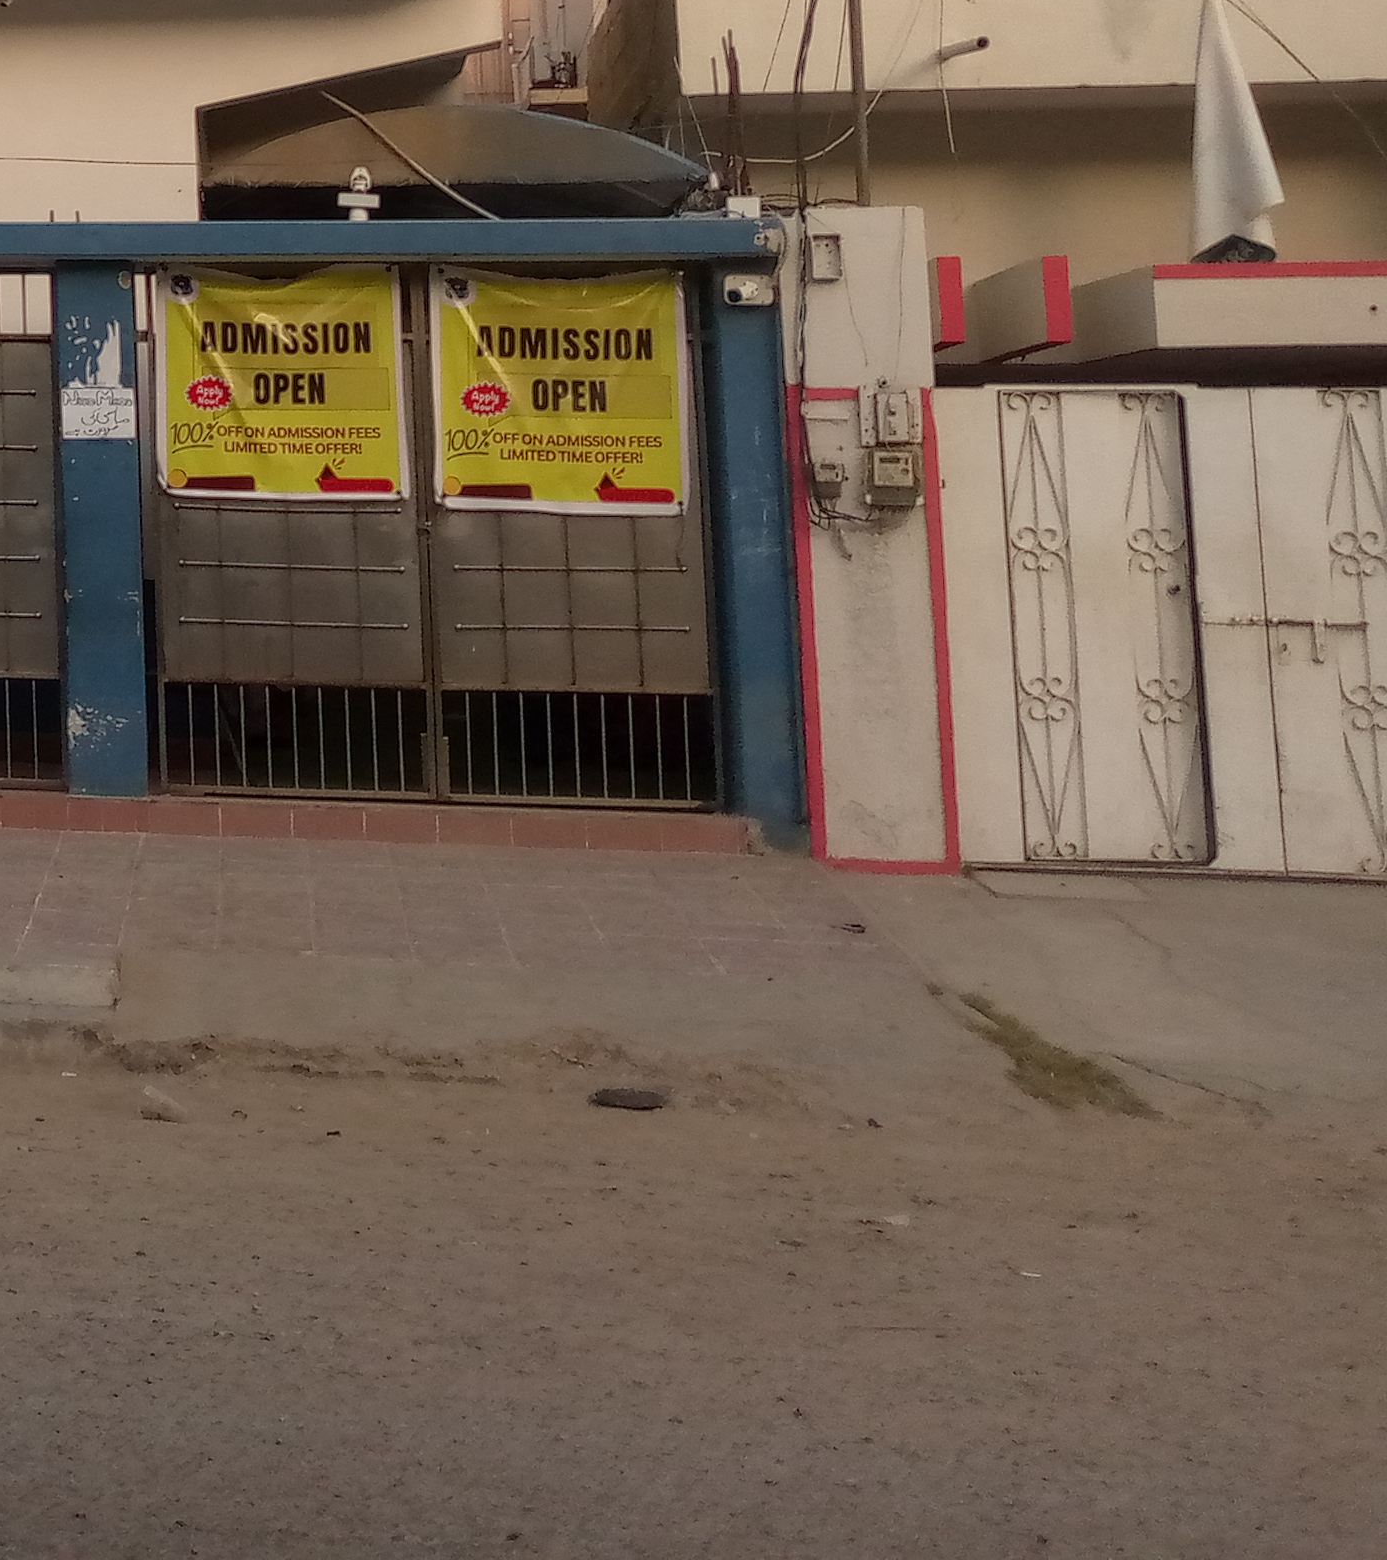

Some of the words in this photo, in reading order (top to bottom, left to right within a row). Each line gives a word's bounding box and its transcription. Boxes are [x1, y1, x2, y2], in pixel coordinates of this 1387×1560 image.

[200, 320, 372, 355] ADMISSION
[477, 326, 653, 361] ADMISSION
[195, 384, 224, 398] Apply
[253, 372, 326, 405] OPEN
[471, 391, 500, 404] Apply
[531, 379, 608, 413] OPEN
[170, 421, 219, 445] 100%
[216, 425, 243, 438] OFF
[244, 426, 266, 439] ON
[269, 426, 346, 439] ADMISSION
[348, 427, 381, 439] FEES
[445, 428, 494, 452] 100%
[492, 432, 520, 445] OFF
[522, 434, 544, 447] ON
[546, 435, 626, 448] ADMISSION
[629, 435, 663, 448] FEES
[224, 441, 277, 455] LIMITED
[279, 442, 313, 455] TIME
[315, 442, 362, 455] OFFER!
[500, 448, 557, 462] LIMITED
[558, 449, 592, 463] TIME
[594, 451, 644, 464] OFFER!
